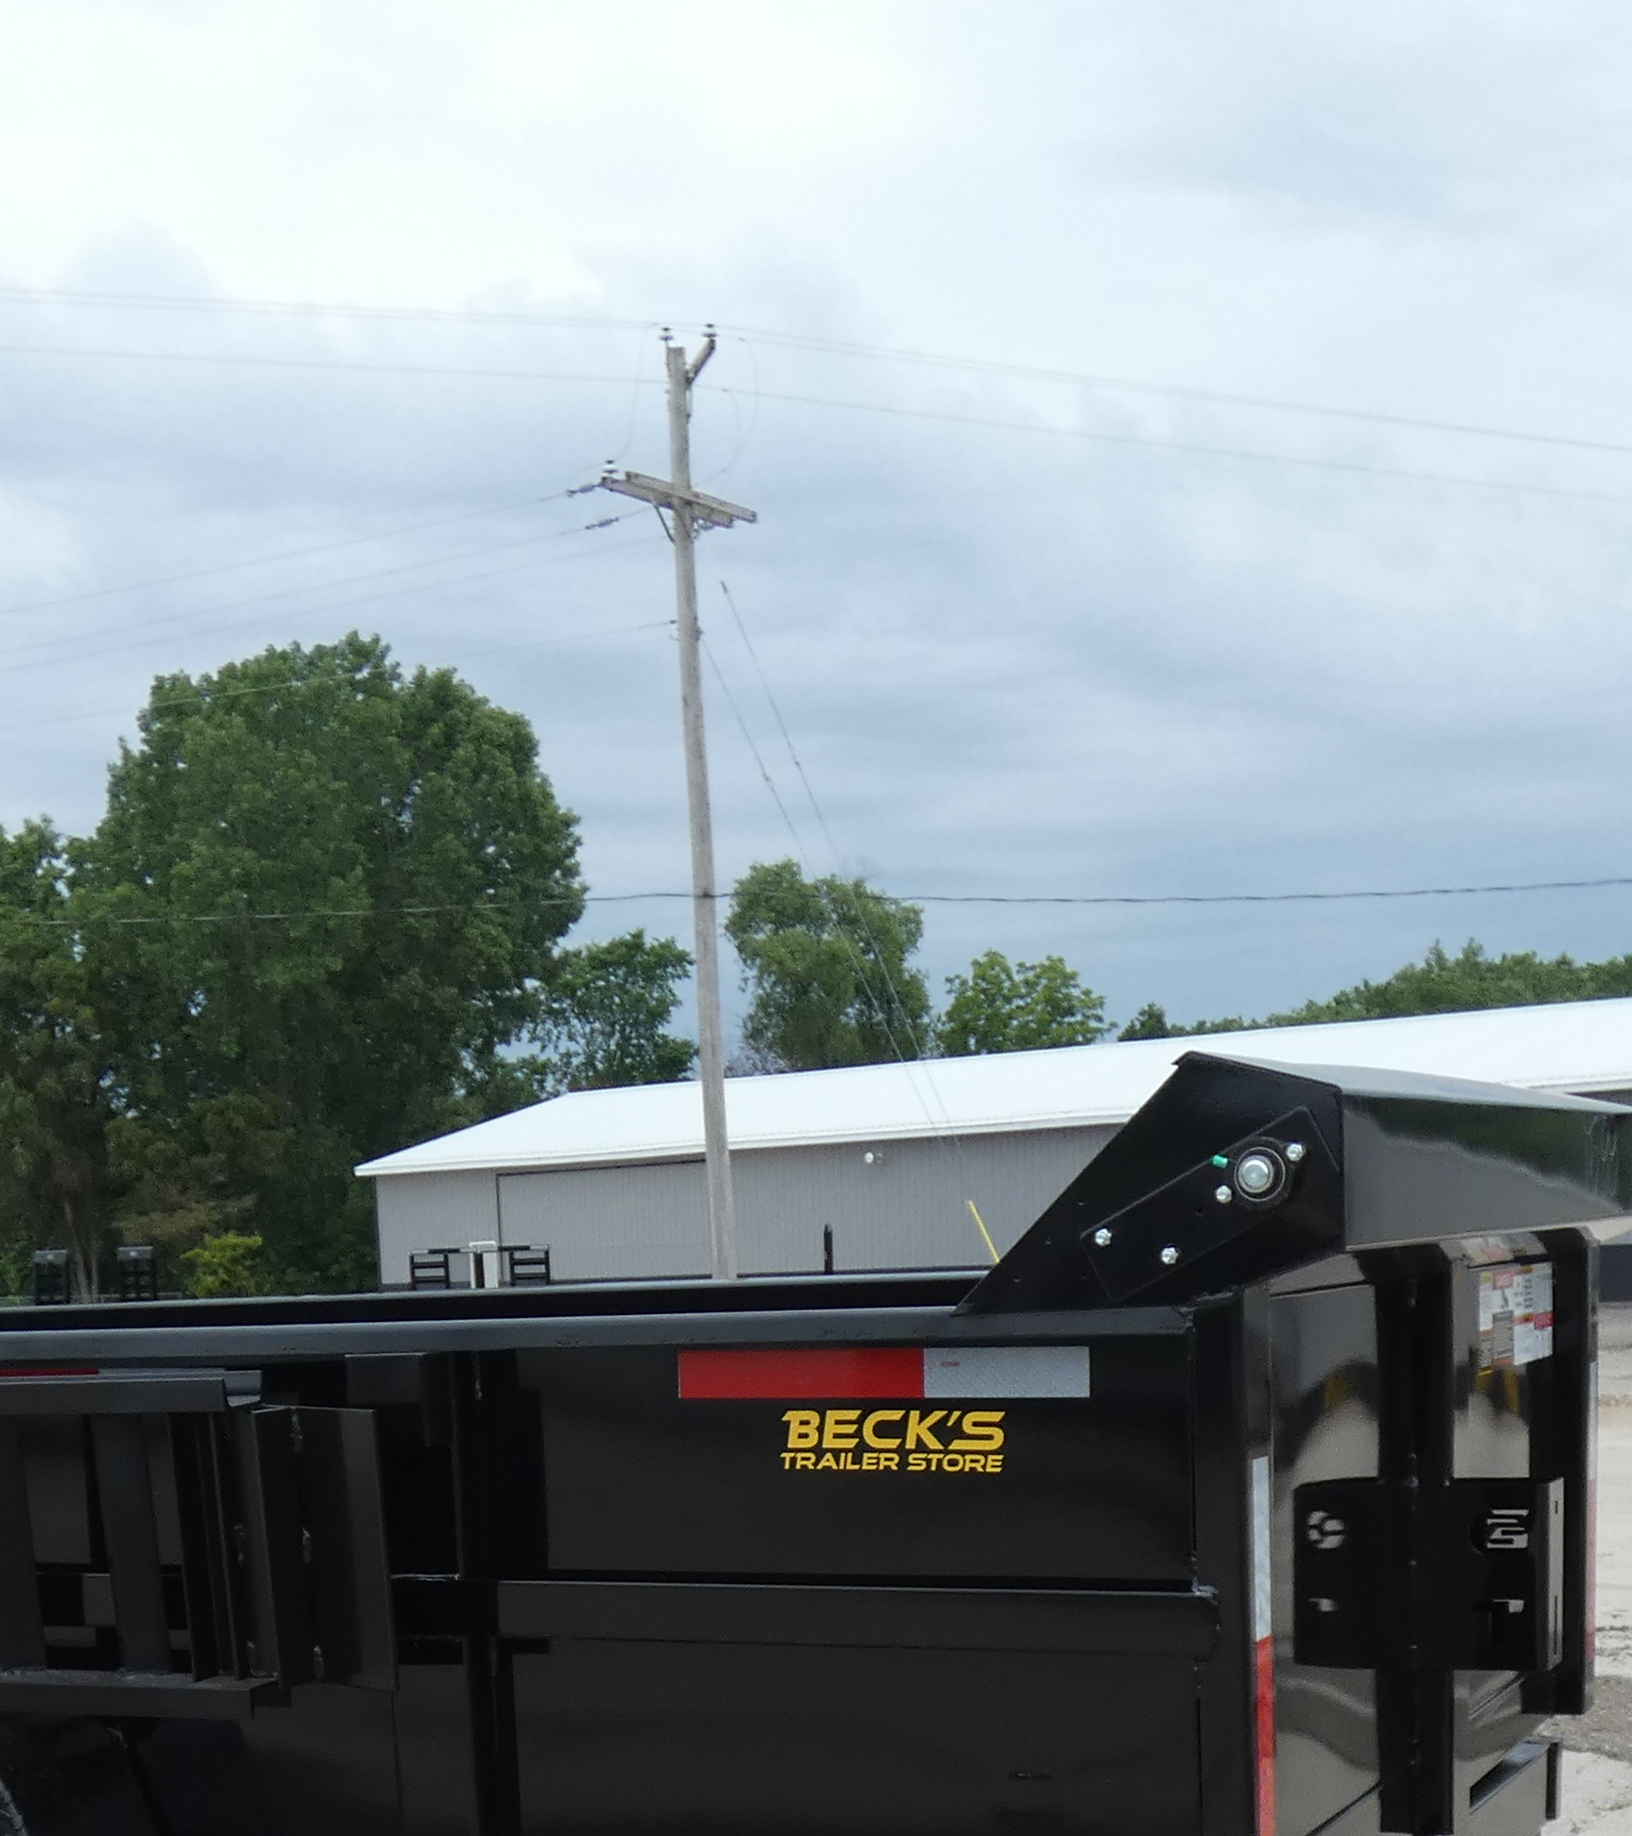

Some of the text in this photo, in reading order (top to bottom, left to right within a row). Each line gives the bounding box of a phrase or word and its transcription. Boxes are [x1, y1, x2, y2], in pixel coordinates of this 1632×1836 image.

[781, 1409, 1007, 1451] BECK'S
[780, 1451, 1006, 1474] TRAILER STORE
